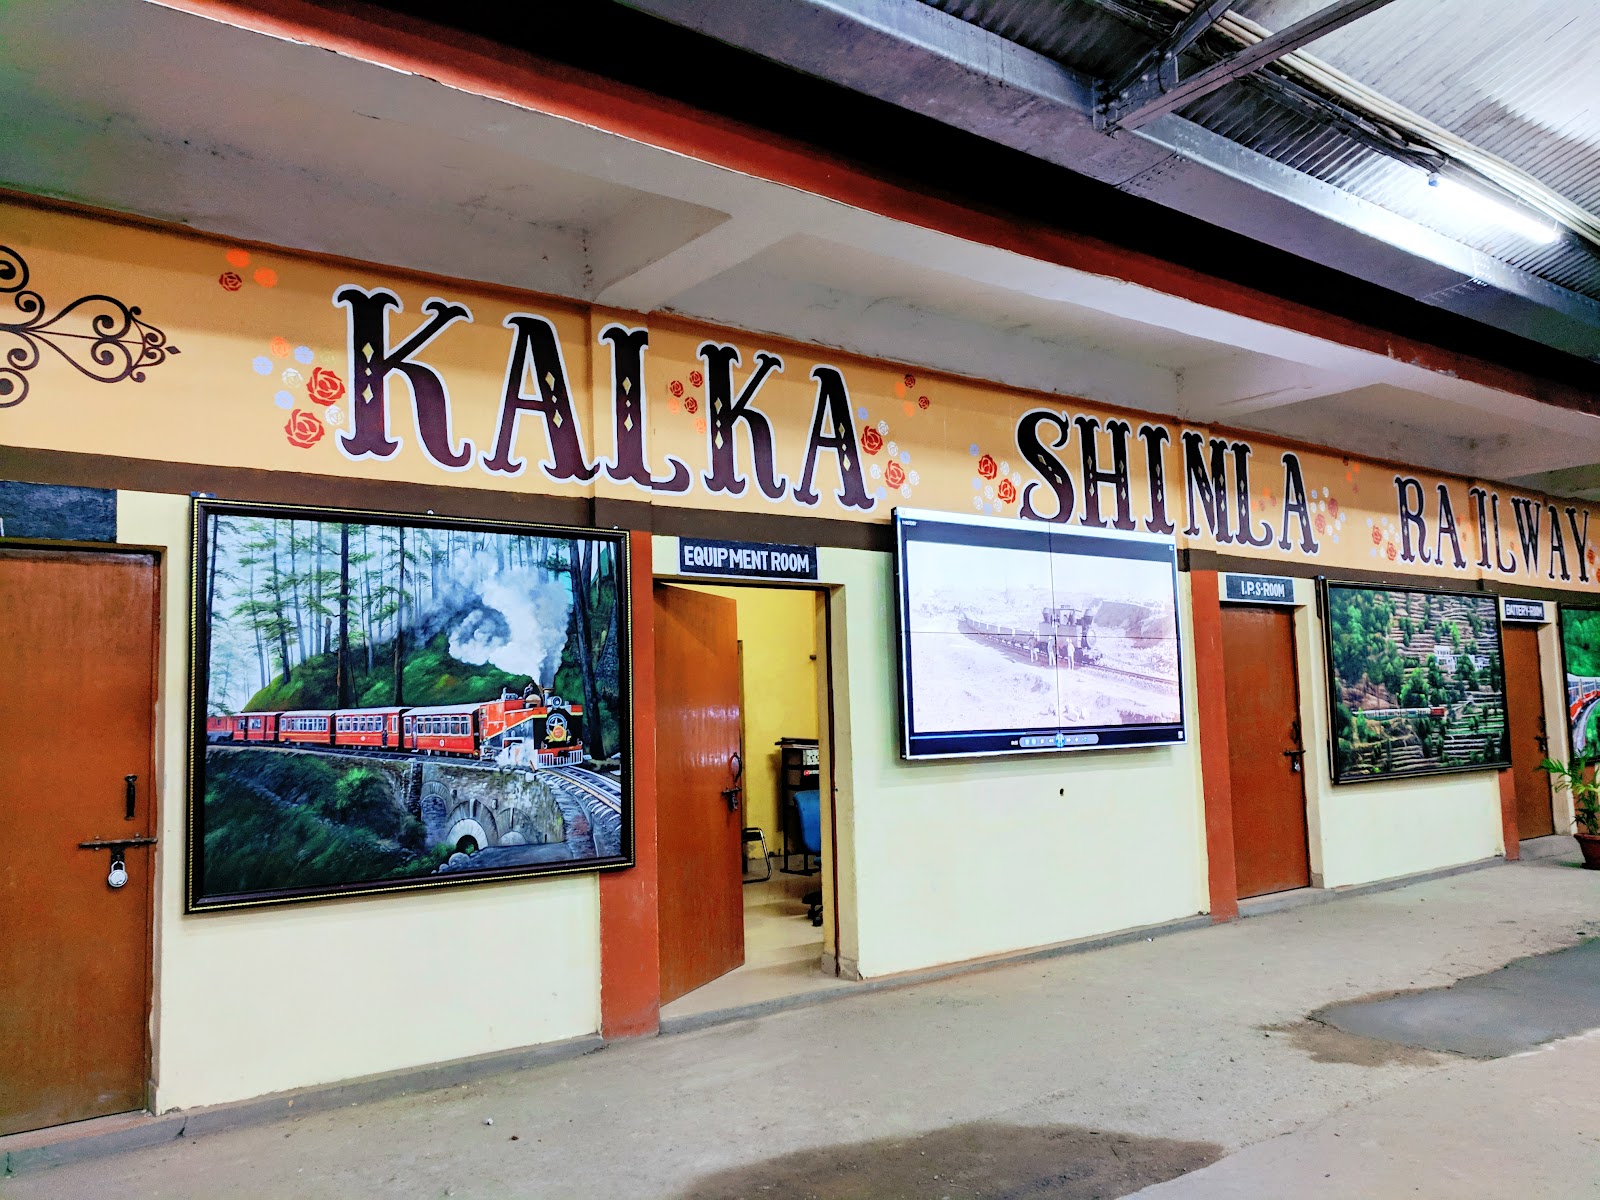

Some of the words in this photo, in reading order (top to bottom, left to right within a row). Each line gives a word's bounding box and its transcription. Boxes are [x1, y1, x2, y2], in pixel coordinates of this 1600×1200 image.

[333, 283, 877, 511] KALKA
[1015, 407, 1320, 555] SHIMLA
[1394, 475, 1590, 584] RAILWAY
[770, 551, 810, 573] ROOM
